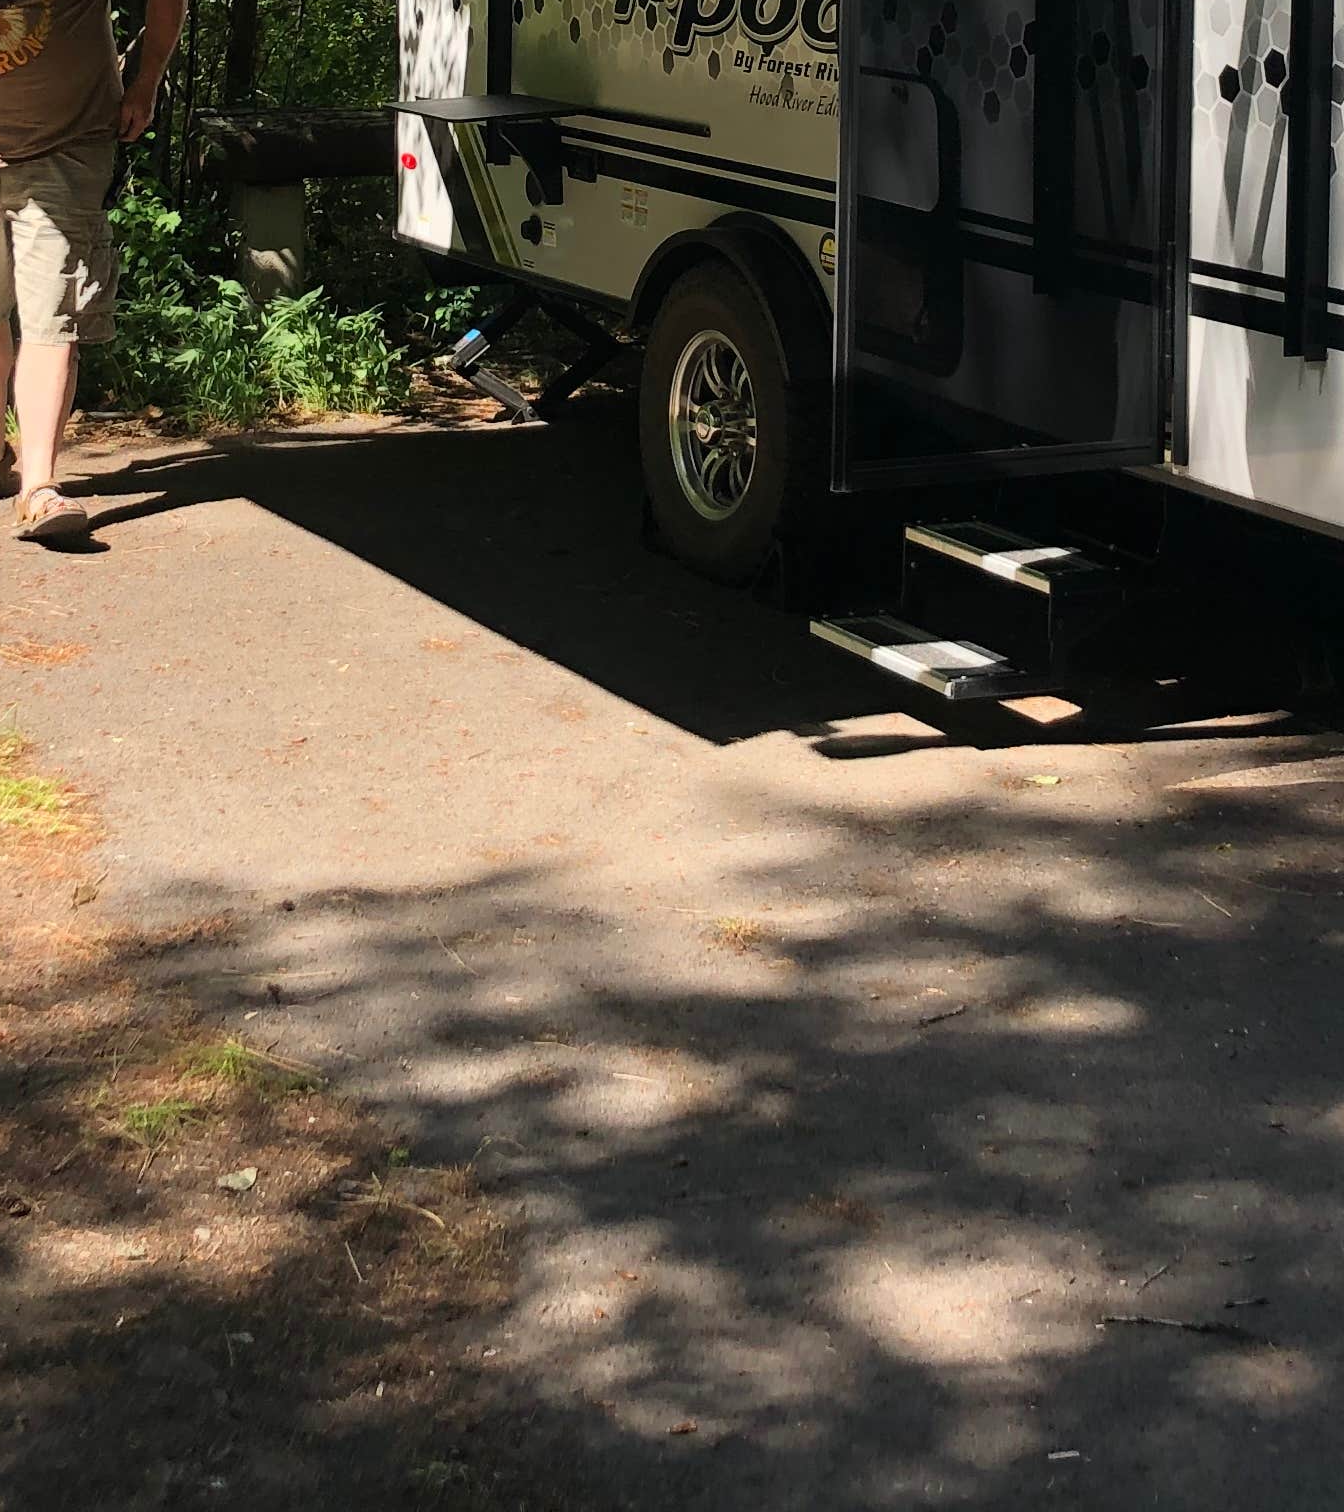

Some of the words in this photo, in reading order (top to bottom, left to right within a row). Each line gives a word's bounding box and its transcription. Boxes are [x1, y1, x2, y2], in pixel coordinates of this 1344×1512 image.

[734, 50, 754, 73] By
[758, 54, 811, 77] Forest
[749, 85, 780, 106] Hood
[783, 89, 814, 112] River
